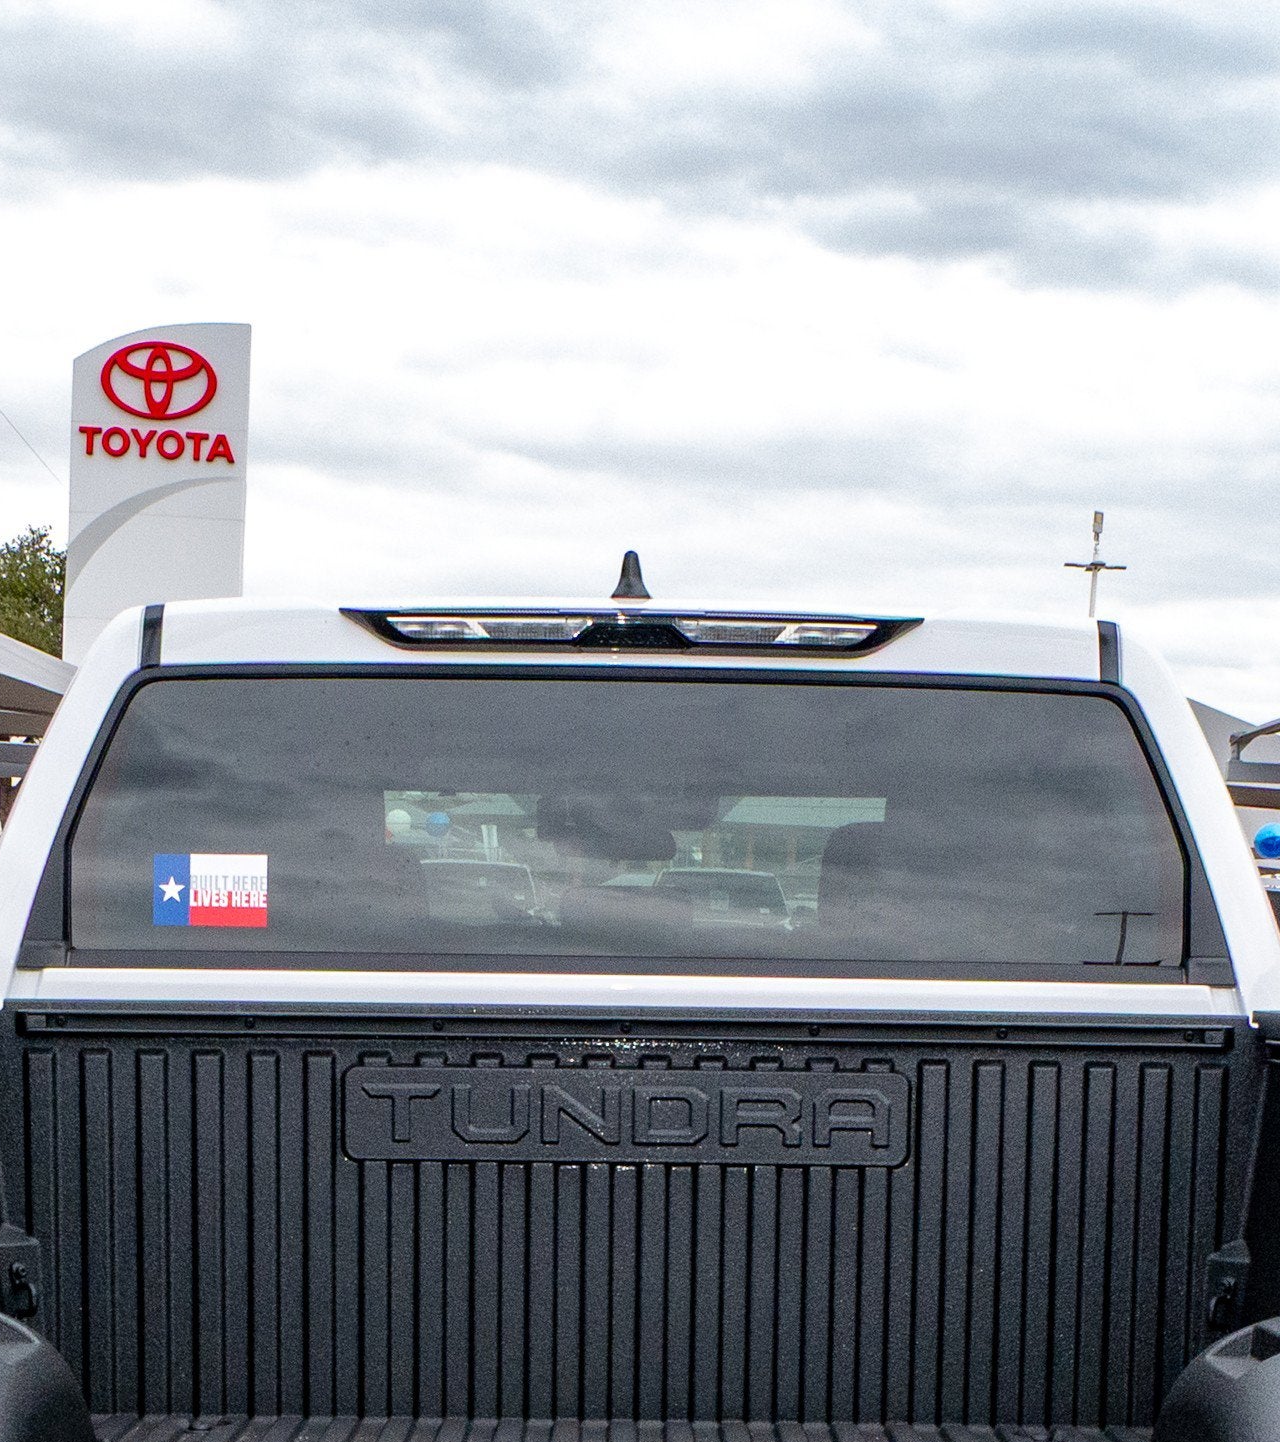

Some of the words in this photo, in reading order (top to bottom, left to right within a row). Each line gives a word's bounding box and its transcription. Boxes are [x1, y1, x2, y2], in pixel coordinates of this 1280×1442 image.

[78, 426, 235, 464] TOYOTA
[190, 875, 229, 890] BUILT
[232, 876, 267, 891] HERE
[190, 890, 228, 907] LIVES
[231, 891, 267, 908] HERE
[360, 1083, 891, 1149] TUNDRA
